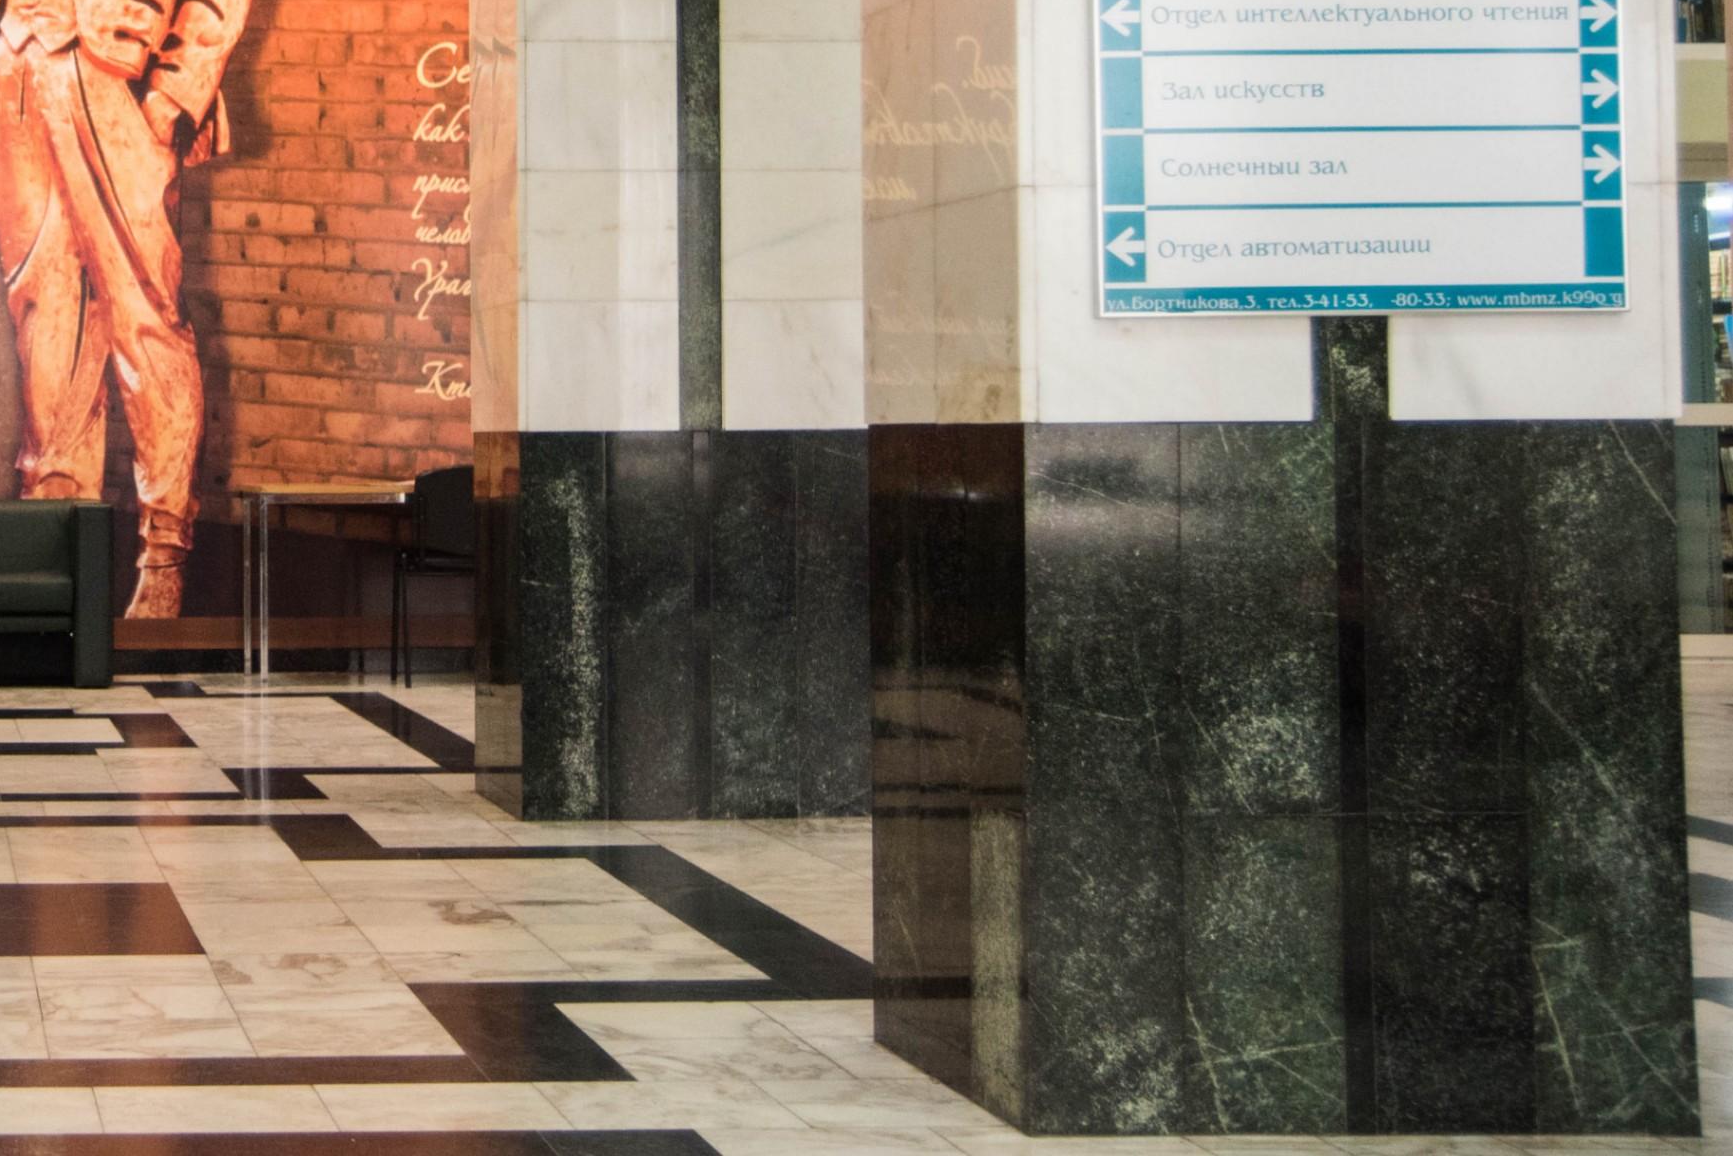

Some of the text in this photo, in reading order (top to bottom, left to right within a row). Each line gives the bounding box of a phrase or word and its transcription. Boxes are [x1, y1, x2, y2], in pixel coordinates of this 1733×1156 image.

[1150, 4, 1569, 28] Отдел интеллектуального чтения
[1163, 81, 1326, 104] Зал искусств
[413, 103, 470, 143] как
[1309, 160, 1348, 176] зал
[1157, 239, 1431, 263] Отдел автоматизации
[1392, 292, 1453, 307] -80-33;
[1457, 290, 1624, 307] www.mbmz.k99og
